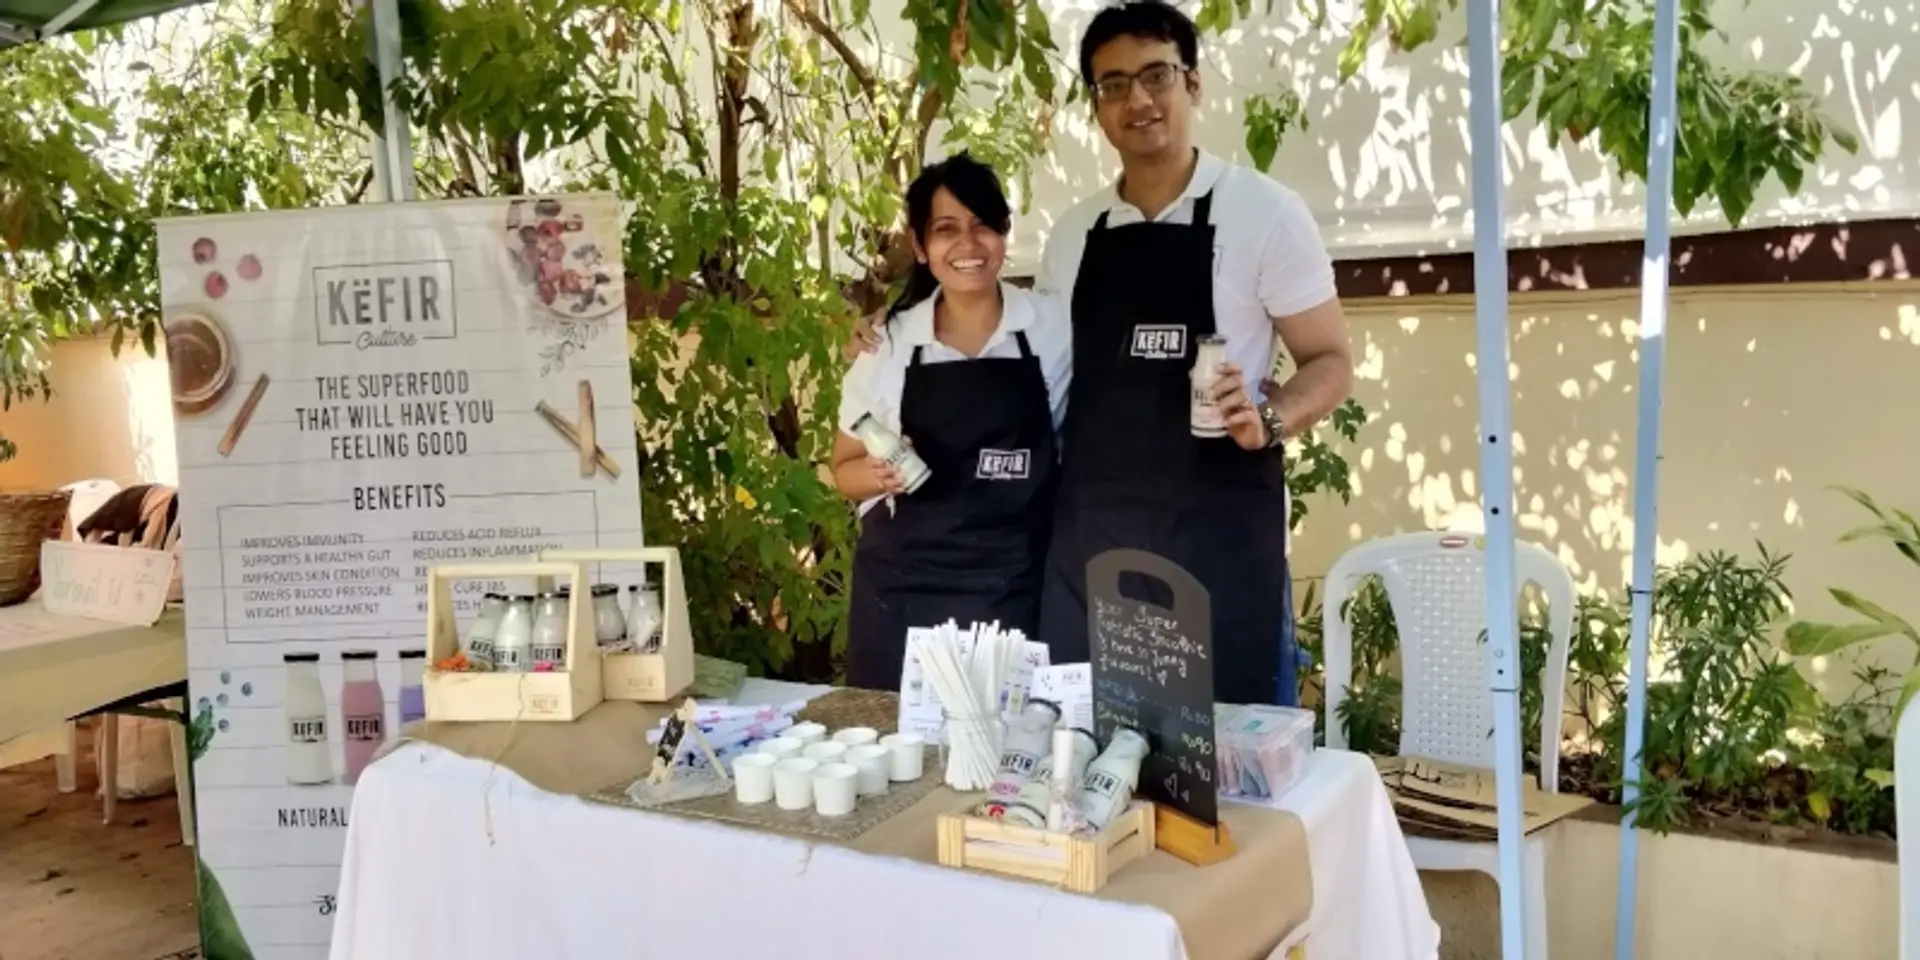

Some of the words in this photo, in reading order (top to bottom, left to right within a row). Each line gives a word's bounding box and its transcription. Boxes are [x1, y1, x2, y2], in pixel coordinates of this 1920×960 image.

[356, 325, 418, 350] Culture
[316, 376, 350, 401] THE
[358, 370, 469, 398] SUPERFOOD
[295, 406, 341, 431] THAT
[348, 404, 394, 428] WILL
[400, 401, 449, 426] HAVE
[455, 399, 494, 424] YOU
[330, 433, 409, 460] FEELING
[417, 430, 467, 456] GOOD
[354, 482, 445, 510] BENEFITS
[240, 535, 300, 548] IMPROVES
[302, 533, 364, 546] IMMUNITY
[412, 529, 464, 541] REDUCES
[468, 528, 495, 540] ACID
[500, 527, 542, 539] REFLUX
[242, 553, 301, 567] SUPPORTS
[304, 553, 312, 564] A
[314, 551, 364, 563] HEALTHY
[367, 550, 391, 562] GUT
[413, 548, 466, 560] REDUCES
[242, 571, 302, 584] IMPROVES
[305, 569, 330, 581] SKIN
[334, 567, 400, 580] CONDITION
[244, 589, 291, 602] LOWERS
[294, 587, 332, 599] BLOOD
[336, 585, 393, 598] PRESSURE
[454, 581, 485, 593] CURE
[245, 606, 291, 619] WEIGHT
[295, 603, 380, 616] MANAGEMENT
[278, 806, 348, 828] NATURAL
